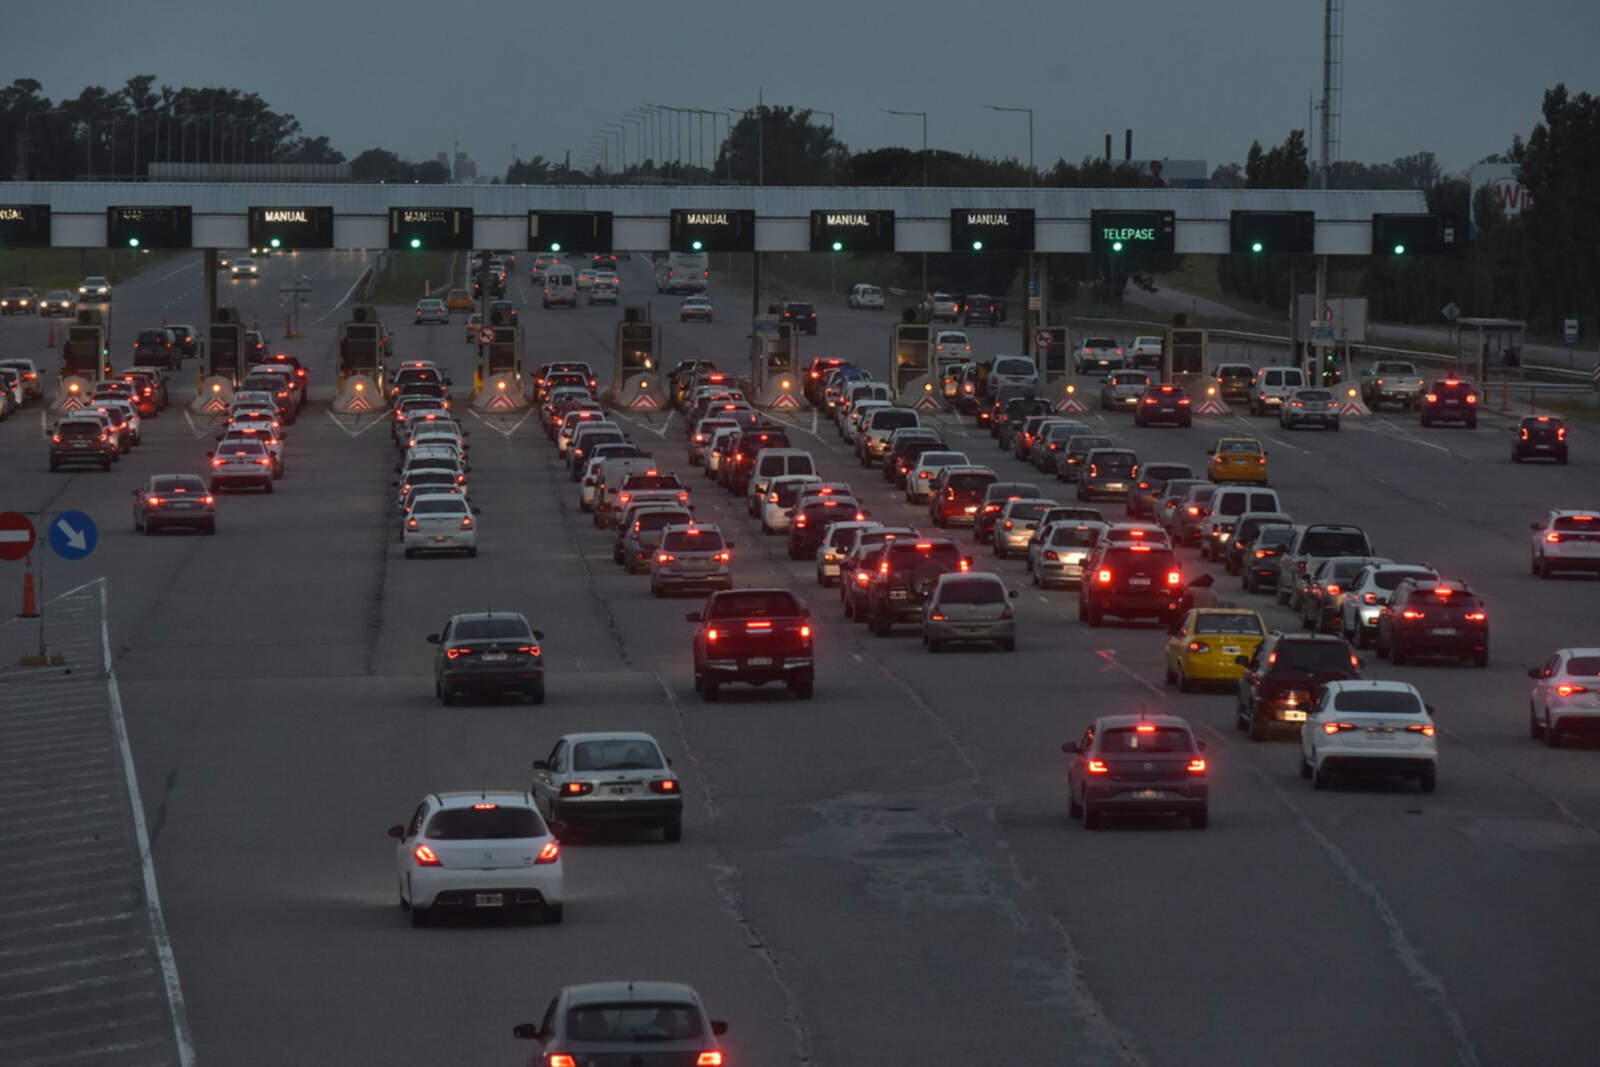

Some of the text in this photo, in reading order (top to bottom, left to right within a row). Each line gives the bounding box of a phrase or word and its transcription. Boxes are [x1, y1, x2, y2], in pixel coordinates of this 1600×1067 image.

[265, 211, 307, 222] MANUAL
[687, 213, 729, 225] MANUAL
[826, 214, 869, 226] MANUAL
[967, 214, 1009, 225] MANUAL
[1103, 228, 1155, 240] TELEPASE
